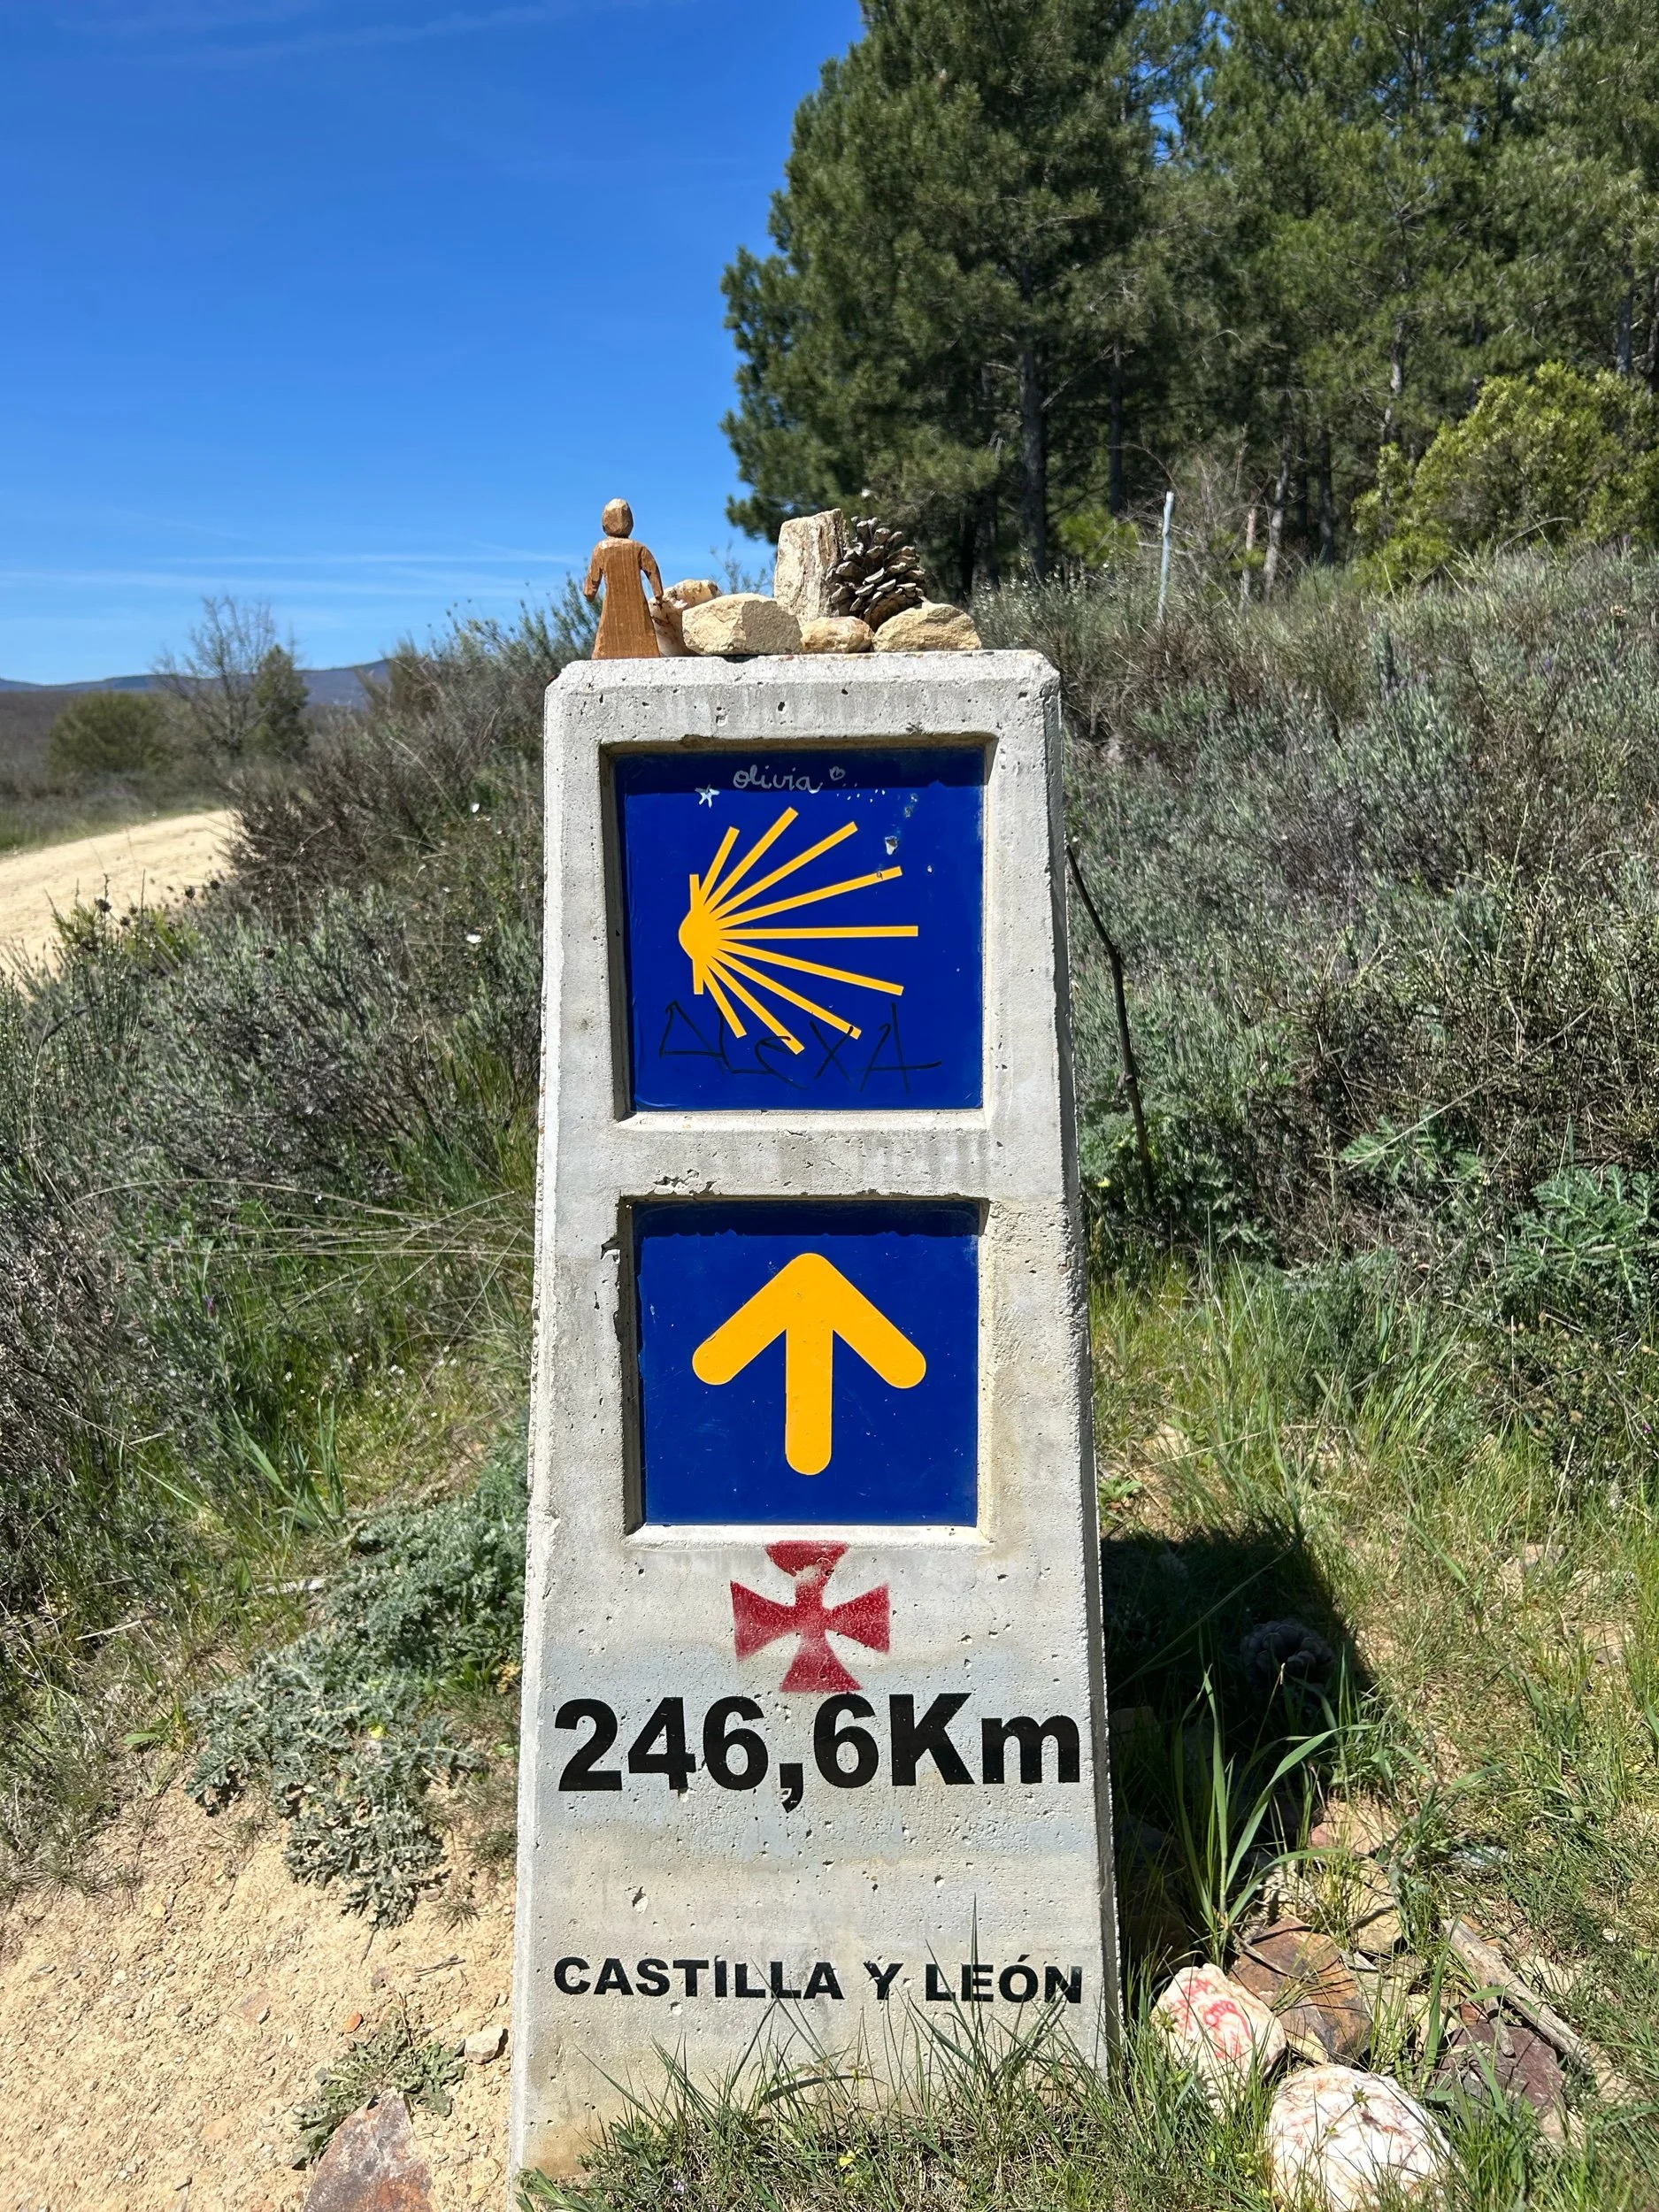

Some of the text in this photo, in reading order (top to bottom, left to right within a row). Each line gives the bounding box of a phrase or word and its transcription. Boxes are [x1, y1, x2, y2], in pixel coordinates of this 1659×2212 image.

[554, 1693, 1080, 1812] 246,6Km
[554, 1954, 1083, 2003] CASTILLA Y LEÓN
